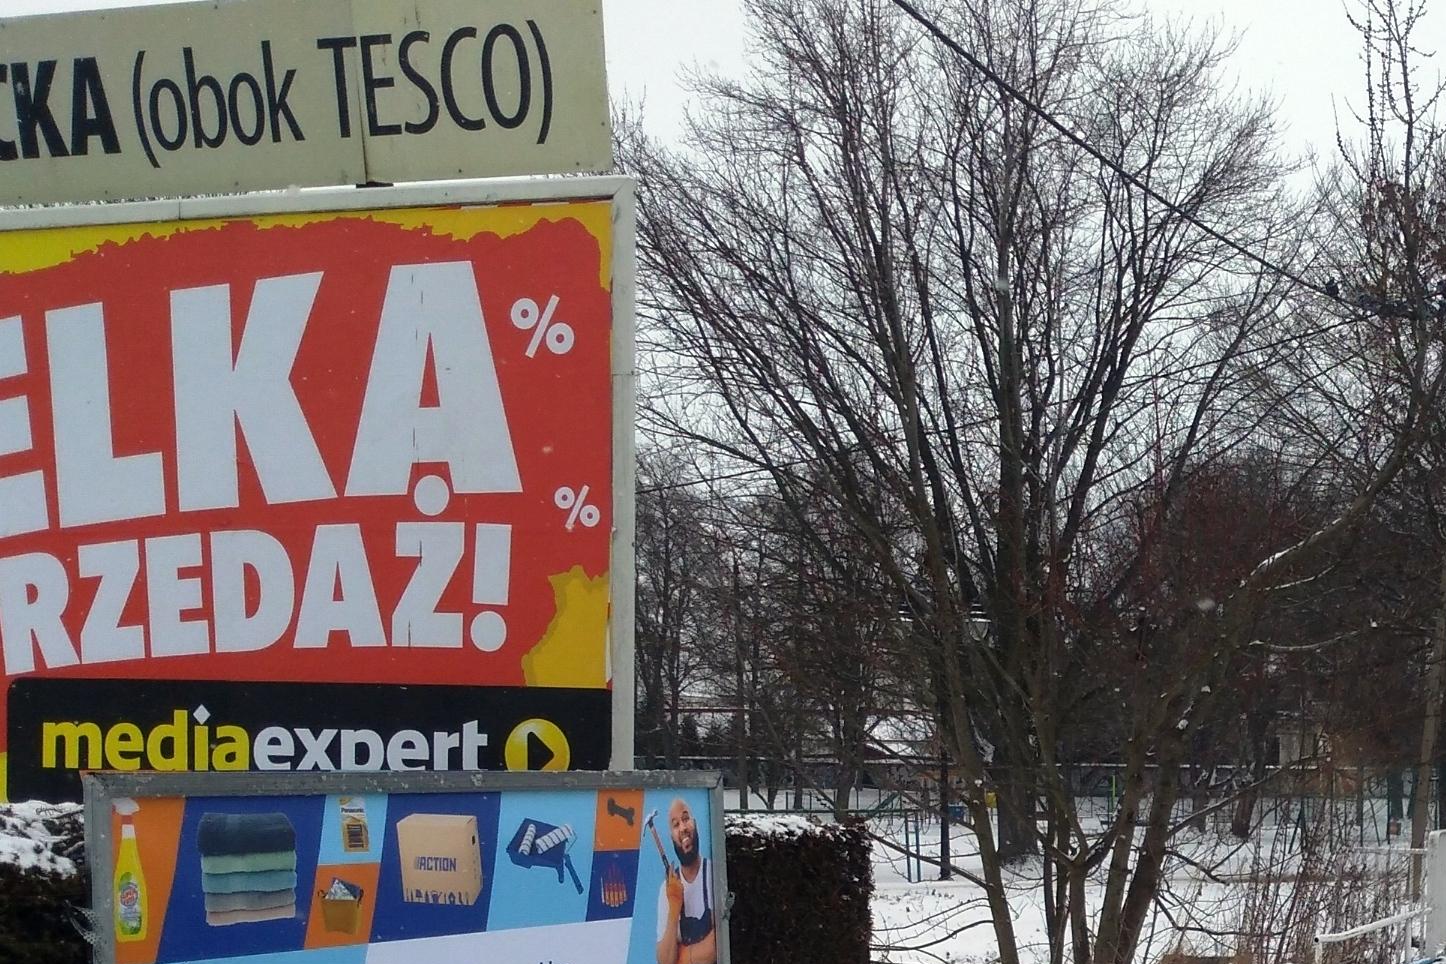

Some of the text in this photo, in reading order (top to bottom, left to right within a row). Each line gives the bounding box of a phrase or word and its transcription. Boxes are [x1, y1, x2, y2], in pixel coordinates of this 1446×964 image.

[133, 40, 306, 169] (obok
[317, 19, 553, 145] TESCO)
[0, 474, 513, 676] RZEDAŻ!
[42, 703, 489, 772] mediaexpert
[419, 856, 457, 872] ACTION
